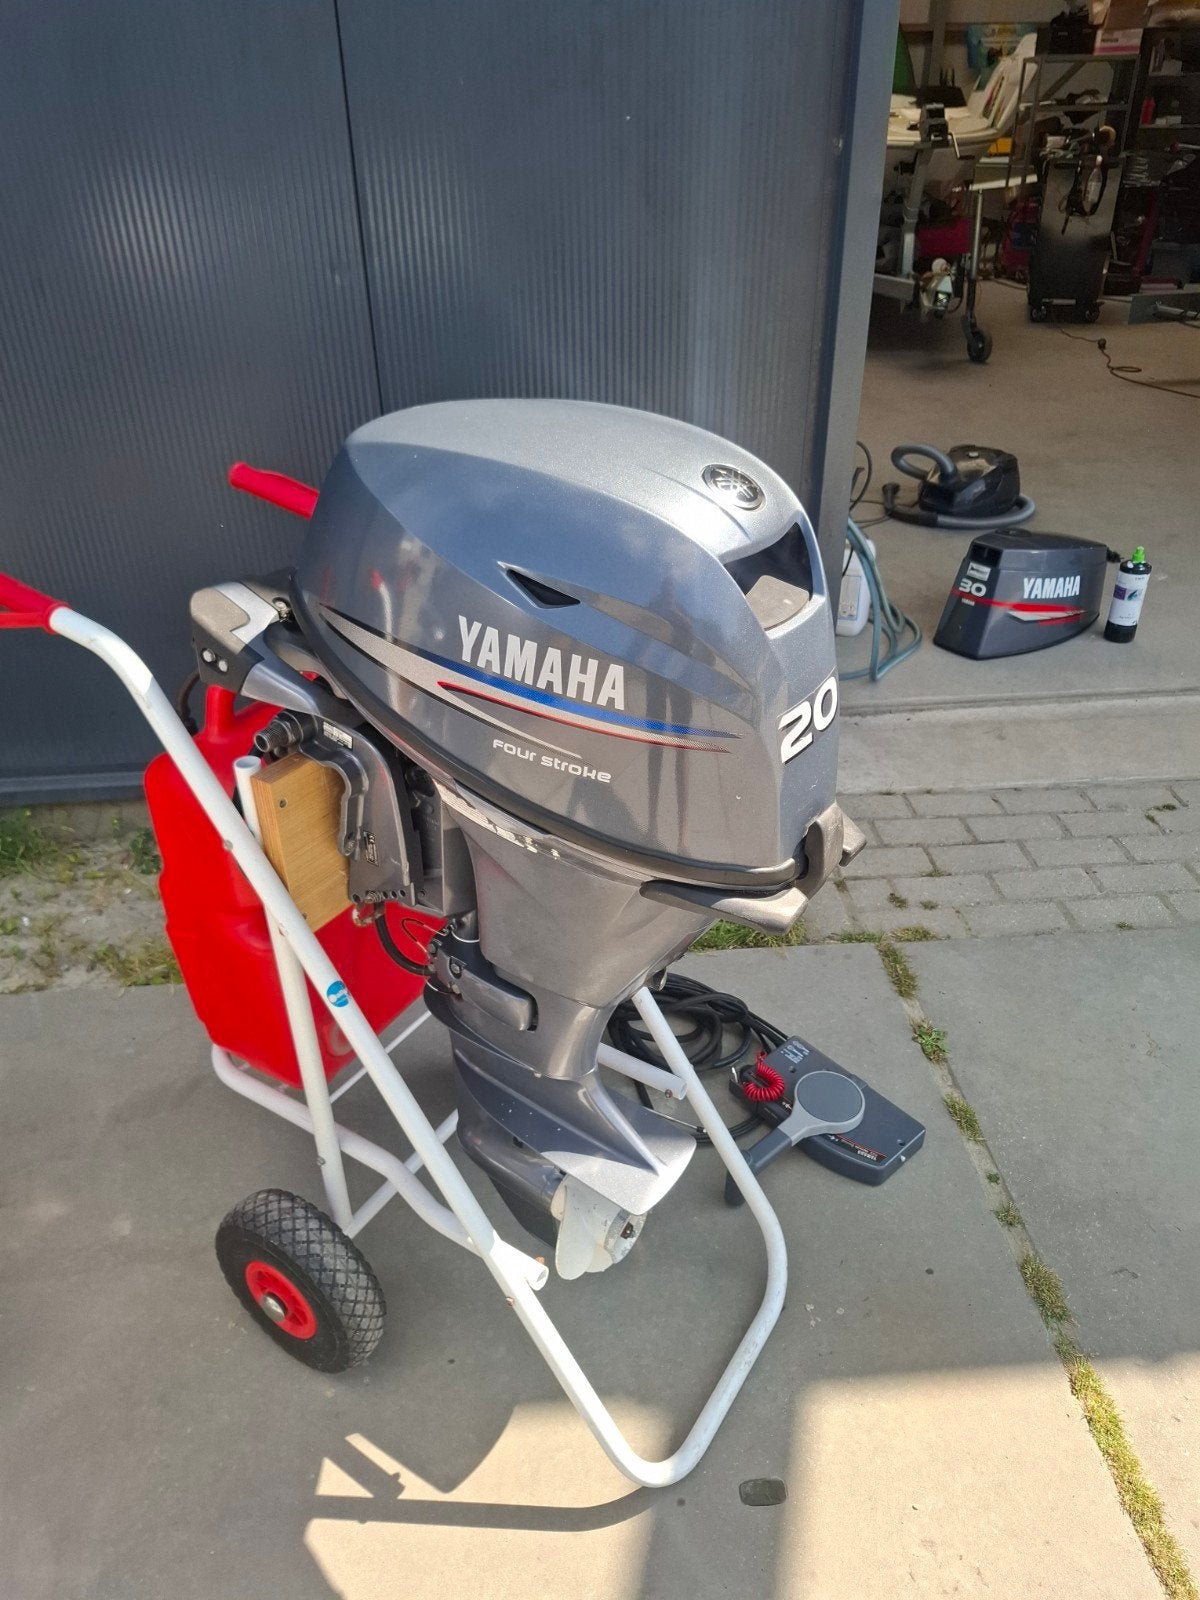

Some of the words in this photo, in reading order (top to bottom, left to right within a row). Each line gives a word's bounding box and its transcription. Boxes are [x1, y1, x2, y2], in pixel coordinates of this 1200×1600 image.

[958, 577, 987, 597] 30
[1023, 575, 1081, 599] YAMAHA
[458, 614, 625, 710] YAMAHA
[778, 676, 838, 764] 20
